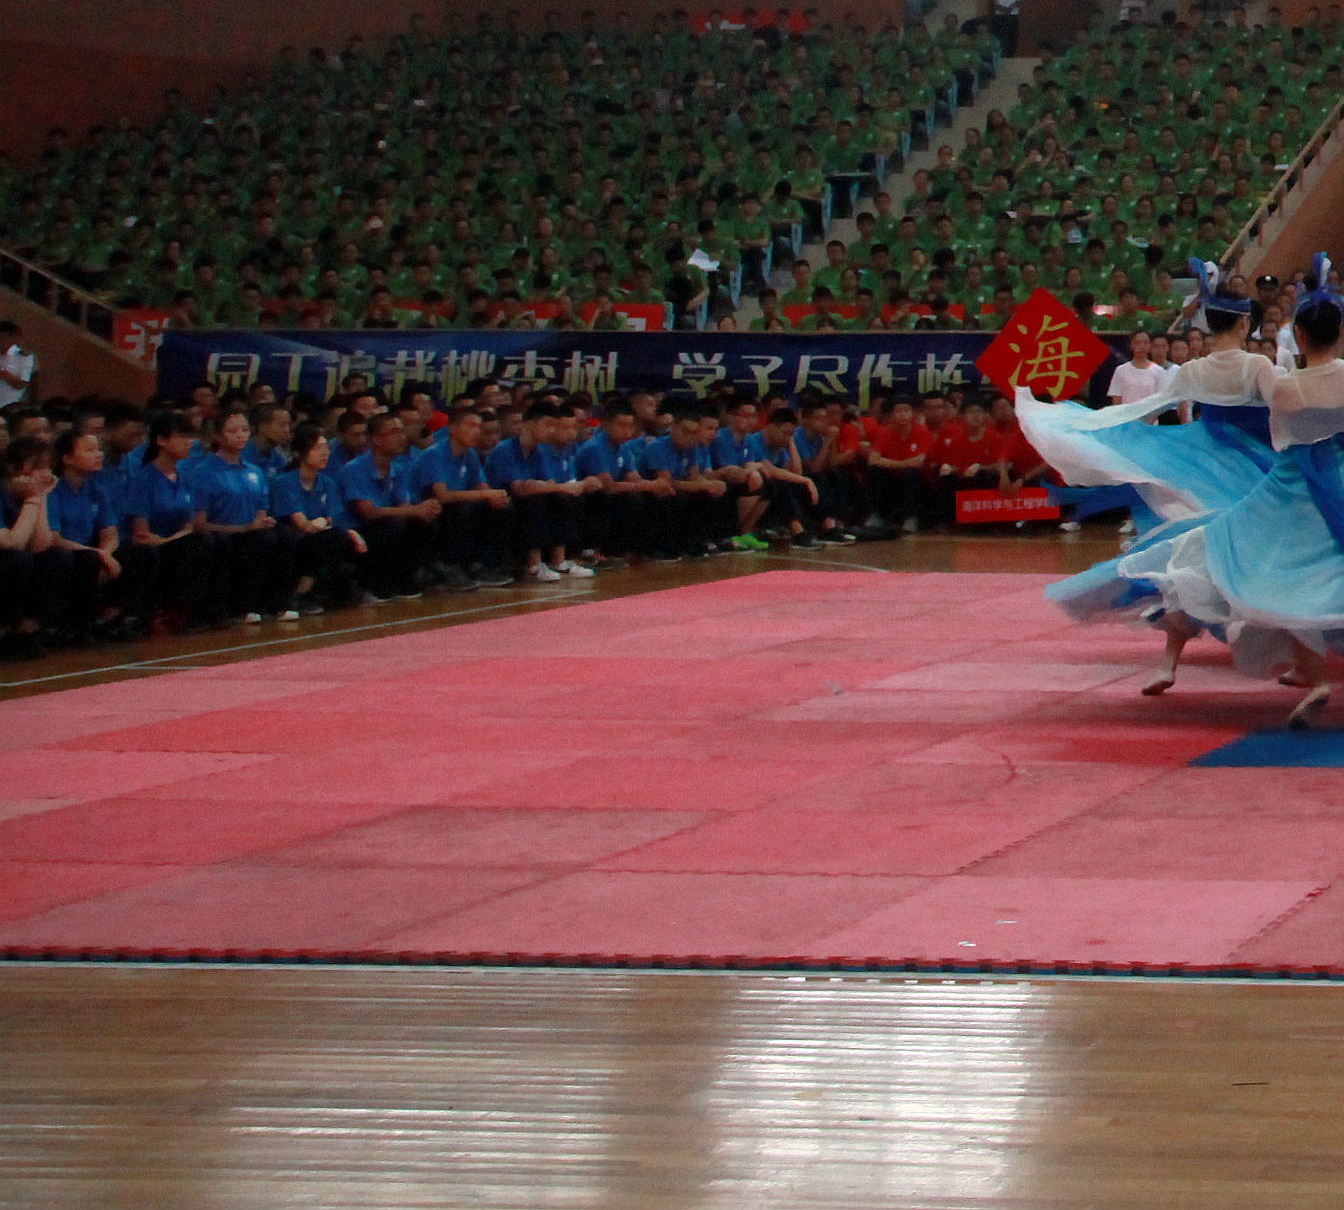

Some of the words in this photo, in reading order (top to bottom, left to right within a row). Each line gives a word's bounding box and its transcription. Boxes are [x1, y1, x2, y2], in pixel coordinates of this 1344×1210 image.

[671, 352, 990, 411] 学子尽作栋
[1008, 314, 1085, 399] 海
